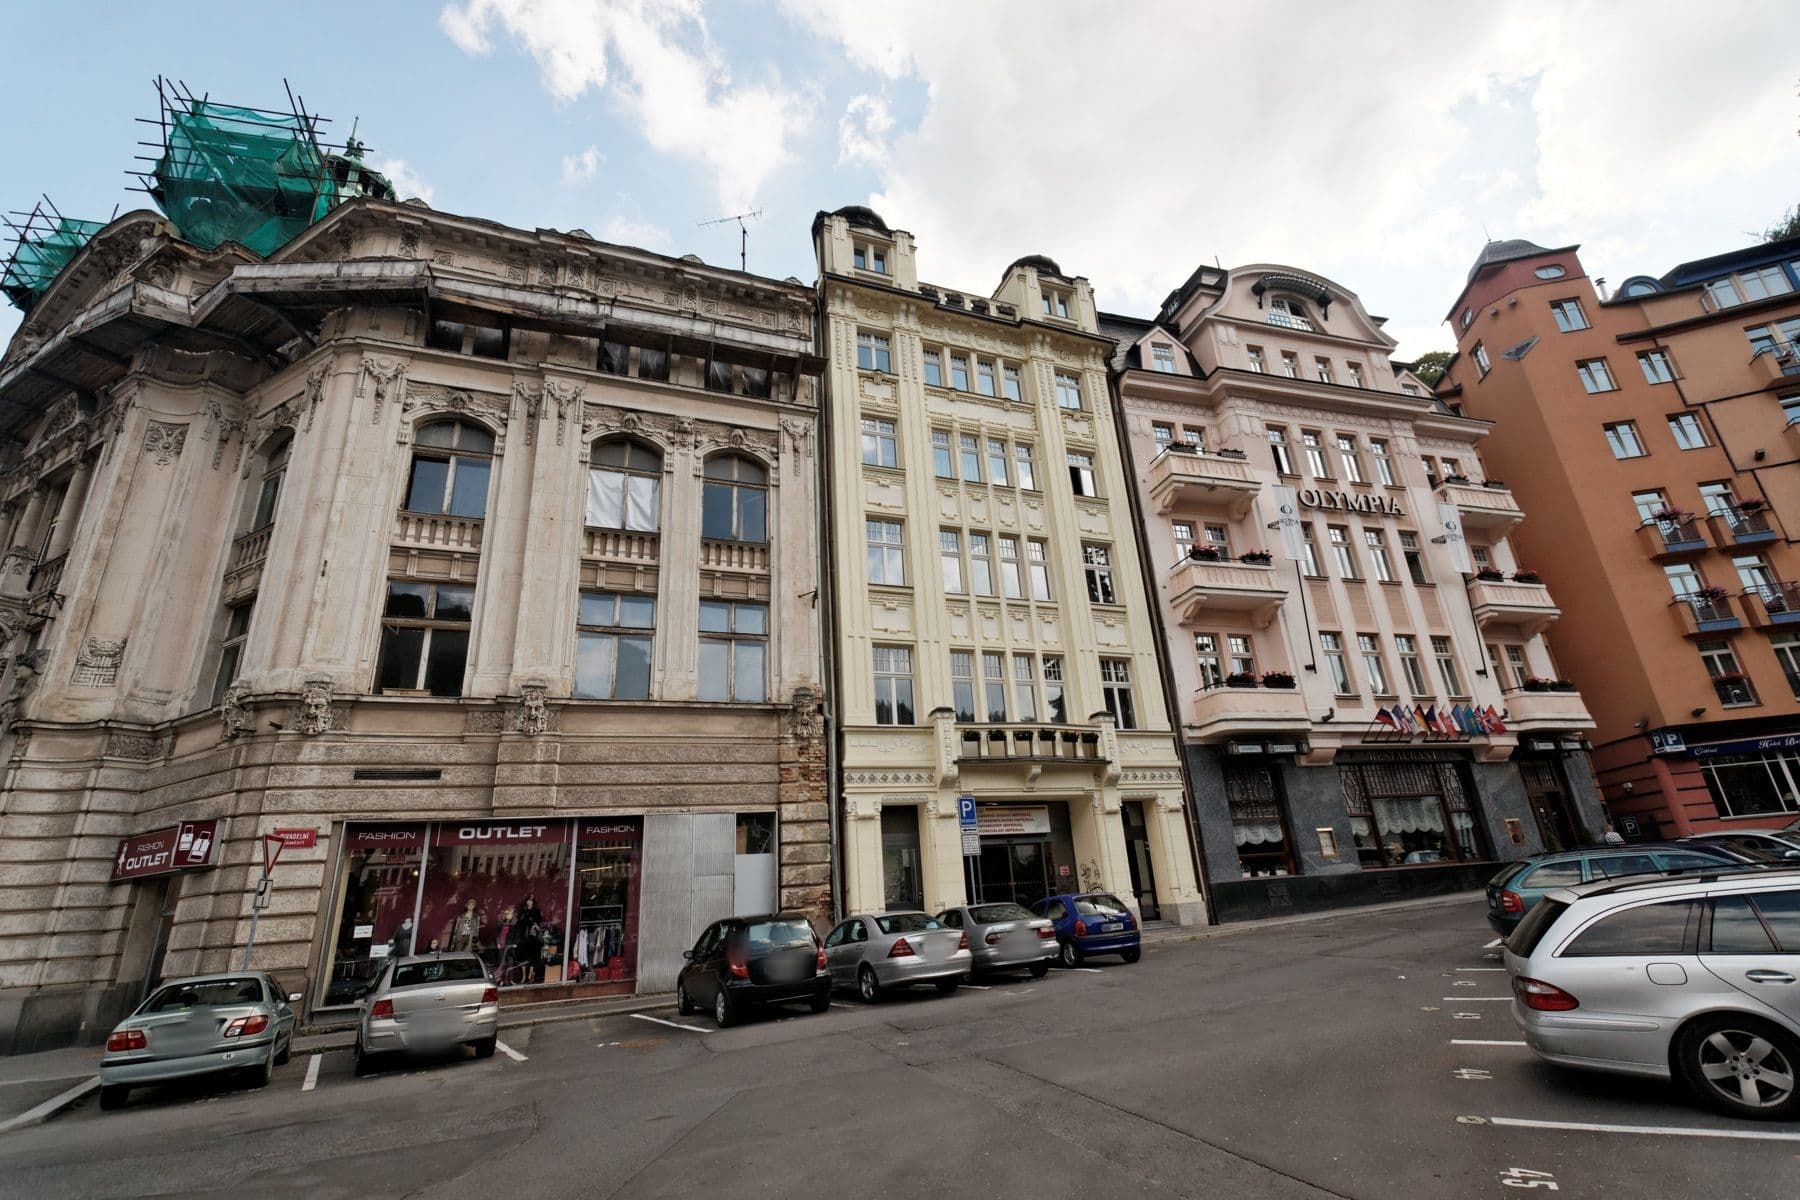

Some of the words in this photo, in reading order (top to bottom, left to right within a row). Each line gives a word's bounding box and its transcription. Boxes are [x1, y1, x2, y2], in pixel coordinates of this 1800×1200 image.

[1297, 488, 1407, 516] OLYMPIA
[1368, 751, 1441, 761] RESTAURANT
[961, 800, 972, 818] P
[358, 831, 416, 841] FASHION
[458, 825, 547, 840] OUTLET
[586, 823, 635, 835] FASHION
[136, 841, 165, 853] FASHION
[126, 852, 169, 870] OUTLET
[1499, 1167, 1559, 1191] 45
